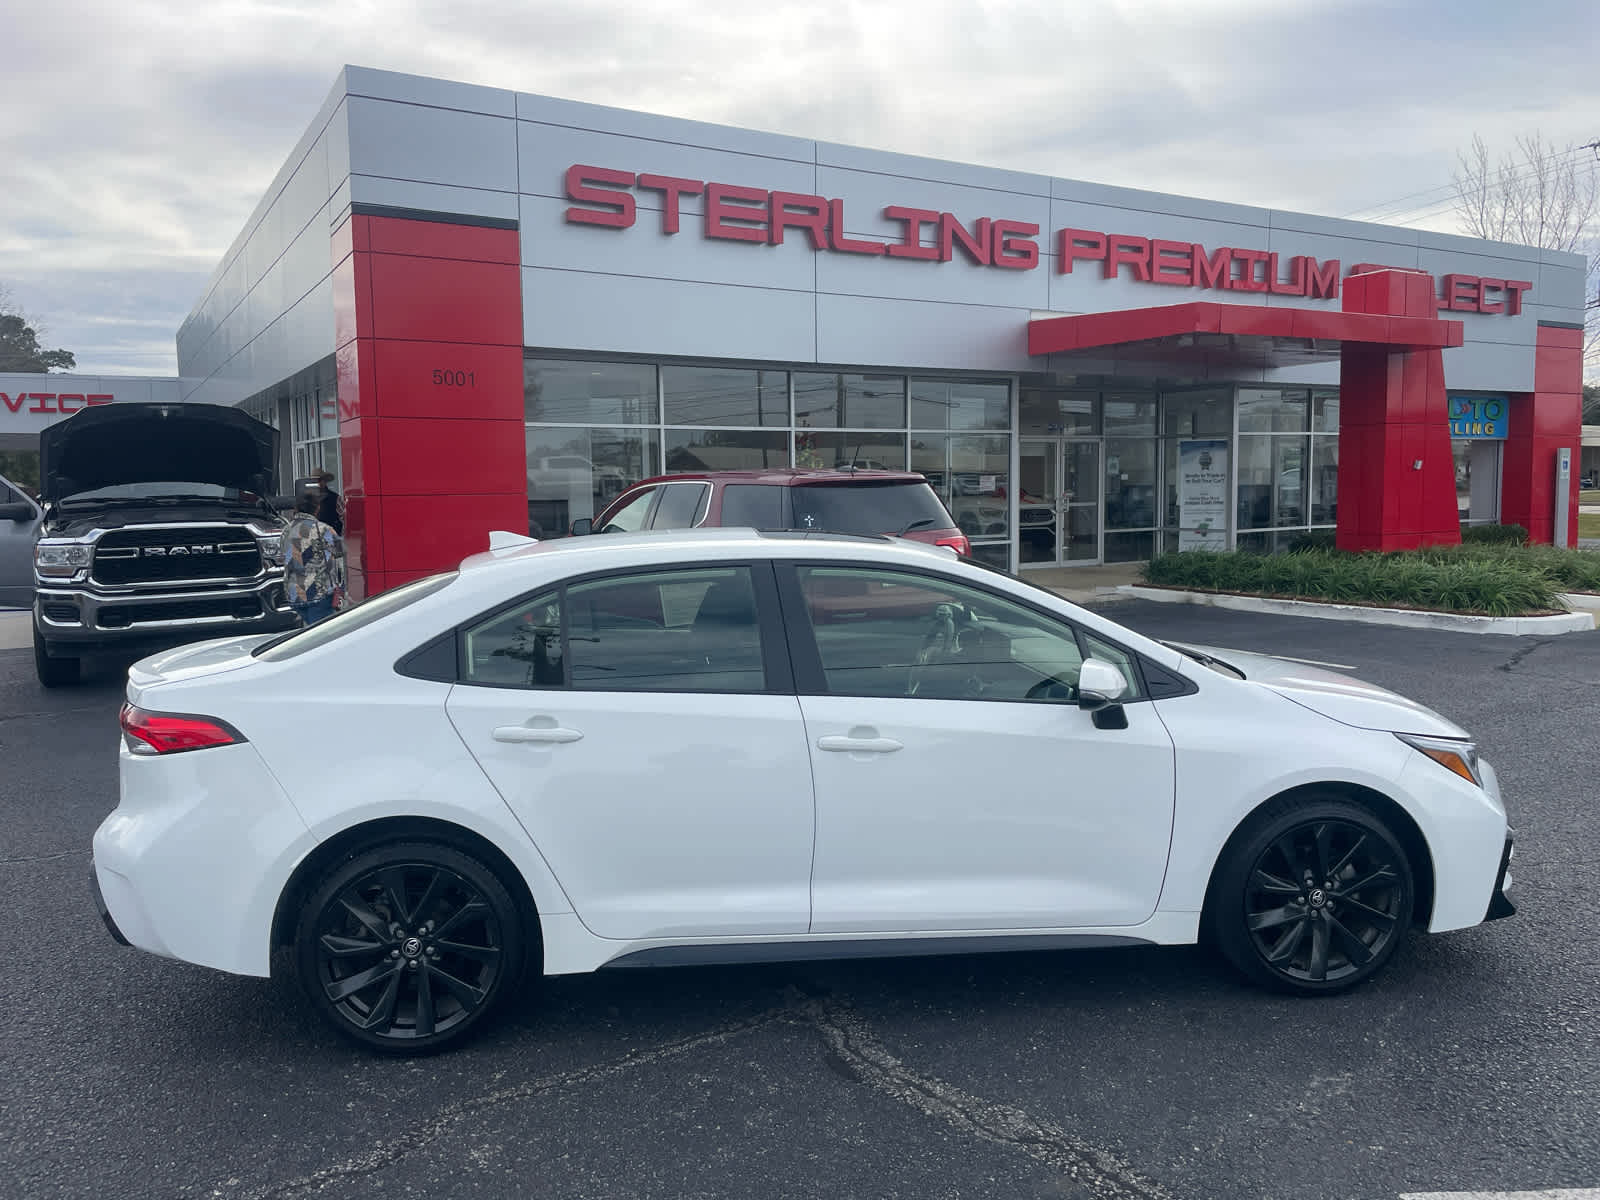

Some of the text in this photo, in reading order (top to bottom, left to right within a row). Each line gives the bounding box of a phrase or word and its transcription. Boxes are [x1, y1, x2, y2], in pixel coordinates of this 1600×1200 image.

[565, 164, 1039, 270] STERLING
[1058, 228, 1340, 299] PREMIUM
[432, 369, 476, 386] 5001
[1448, 421, 1495, 435] LING
[144, 545, 214, 557] RAM
